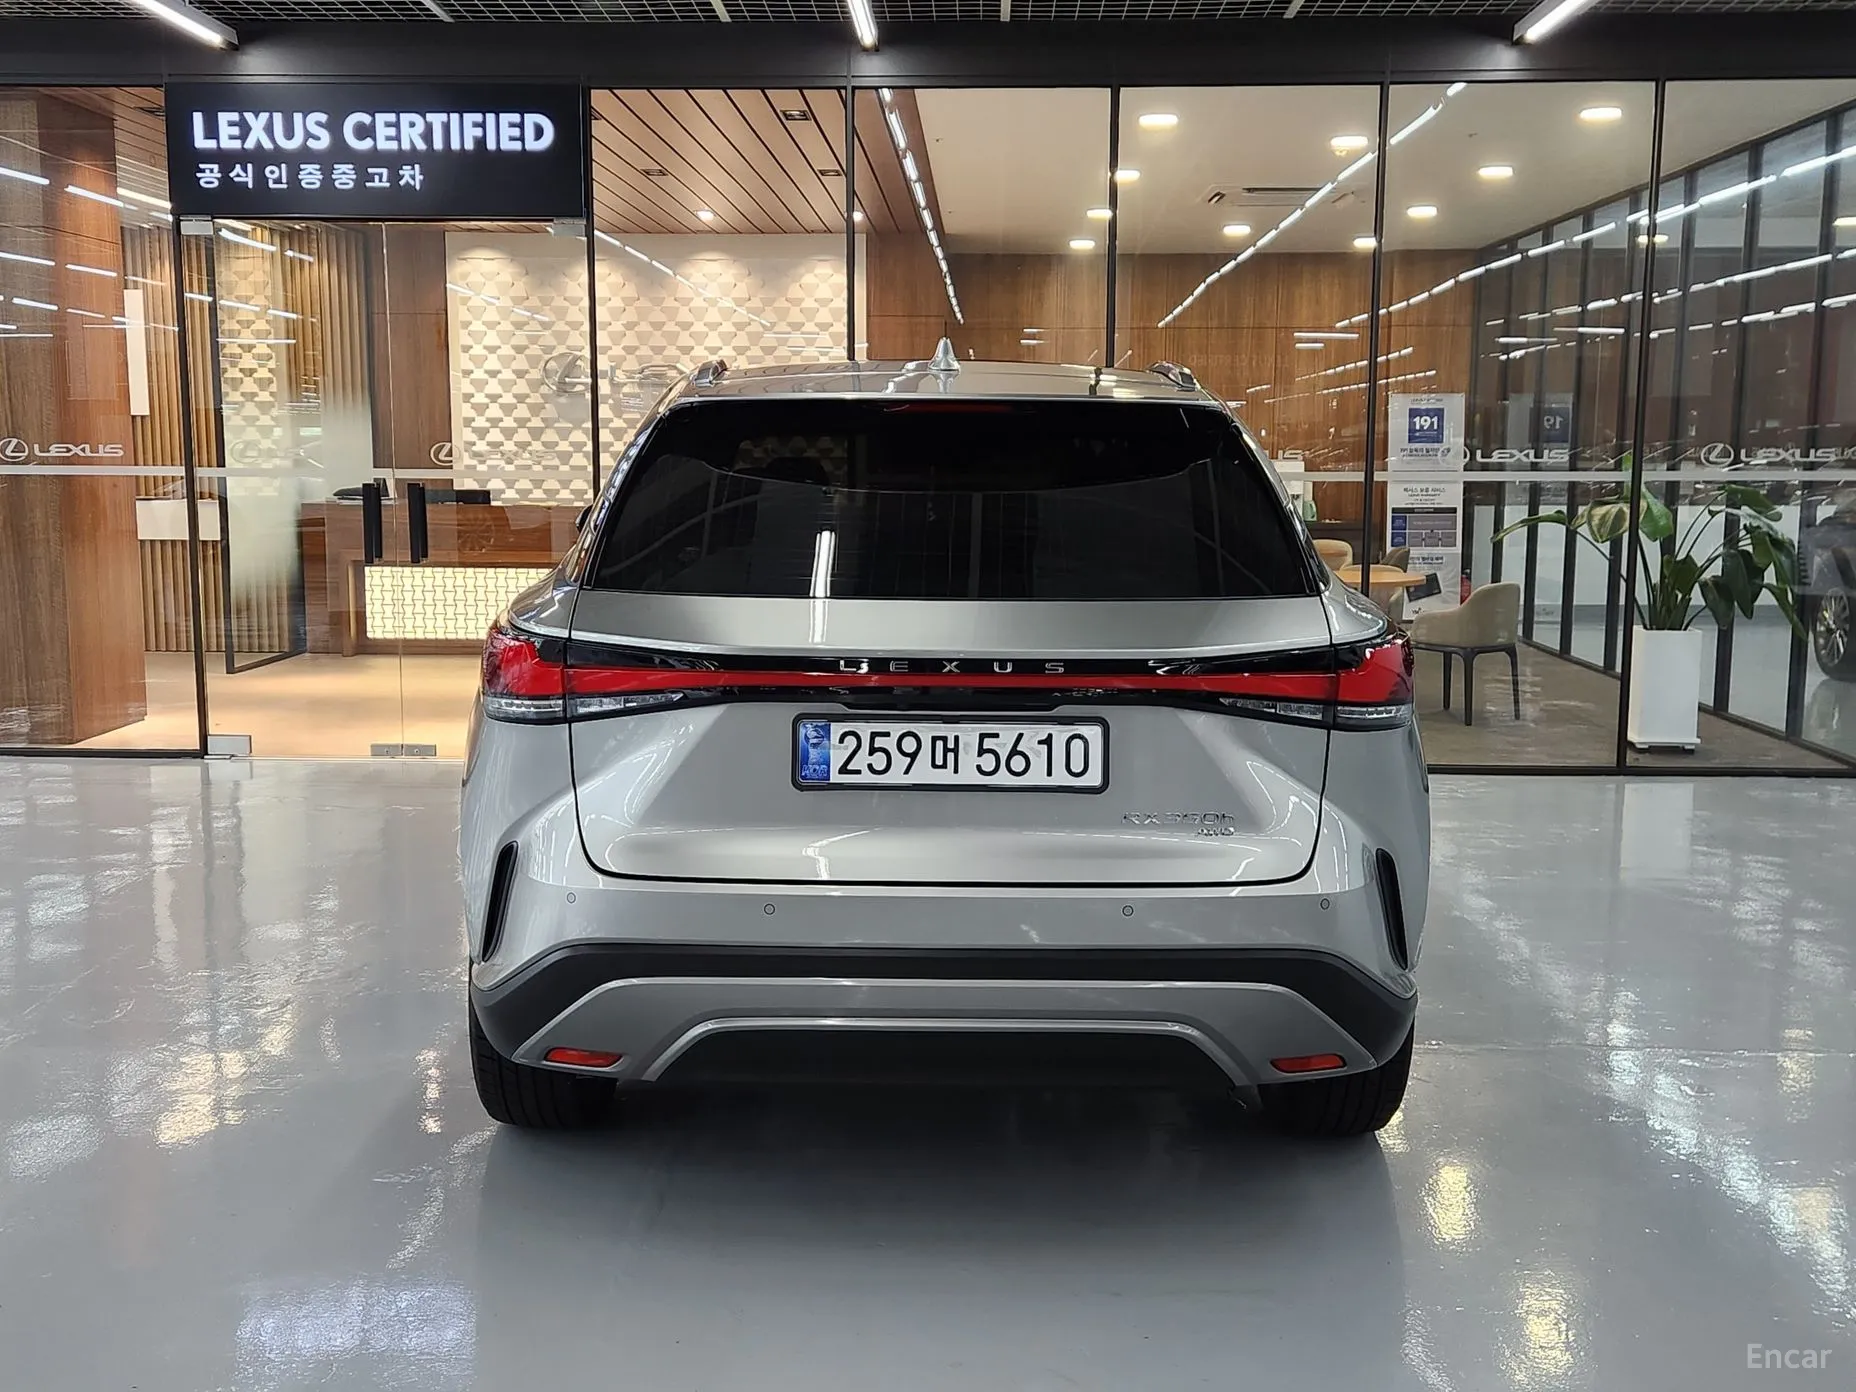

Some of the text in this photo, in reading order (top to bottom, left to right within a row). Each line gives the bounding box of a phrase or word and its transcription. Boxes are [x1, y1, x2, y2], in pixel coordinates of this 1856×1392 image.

[192, 111, 555, 151] LEXUS CERTIFIED
[195, 163, 425, 190] 공식인증중고차
[1413, 416, 1439, 430] 191
[34, 443, 124, 457] LEXUS
[1476, 449, 1569, 462] LEXUS
[1740, 448, 1836, 462] LEXUS
[839, 659, 1064, 674] LEXUS
[838, 730, 1090, 778] 259머 5610
